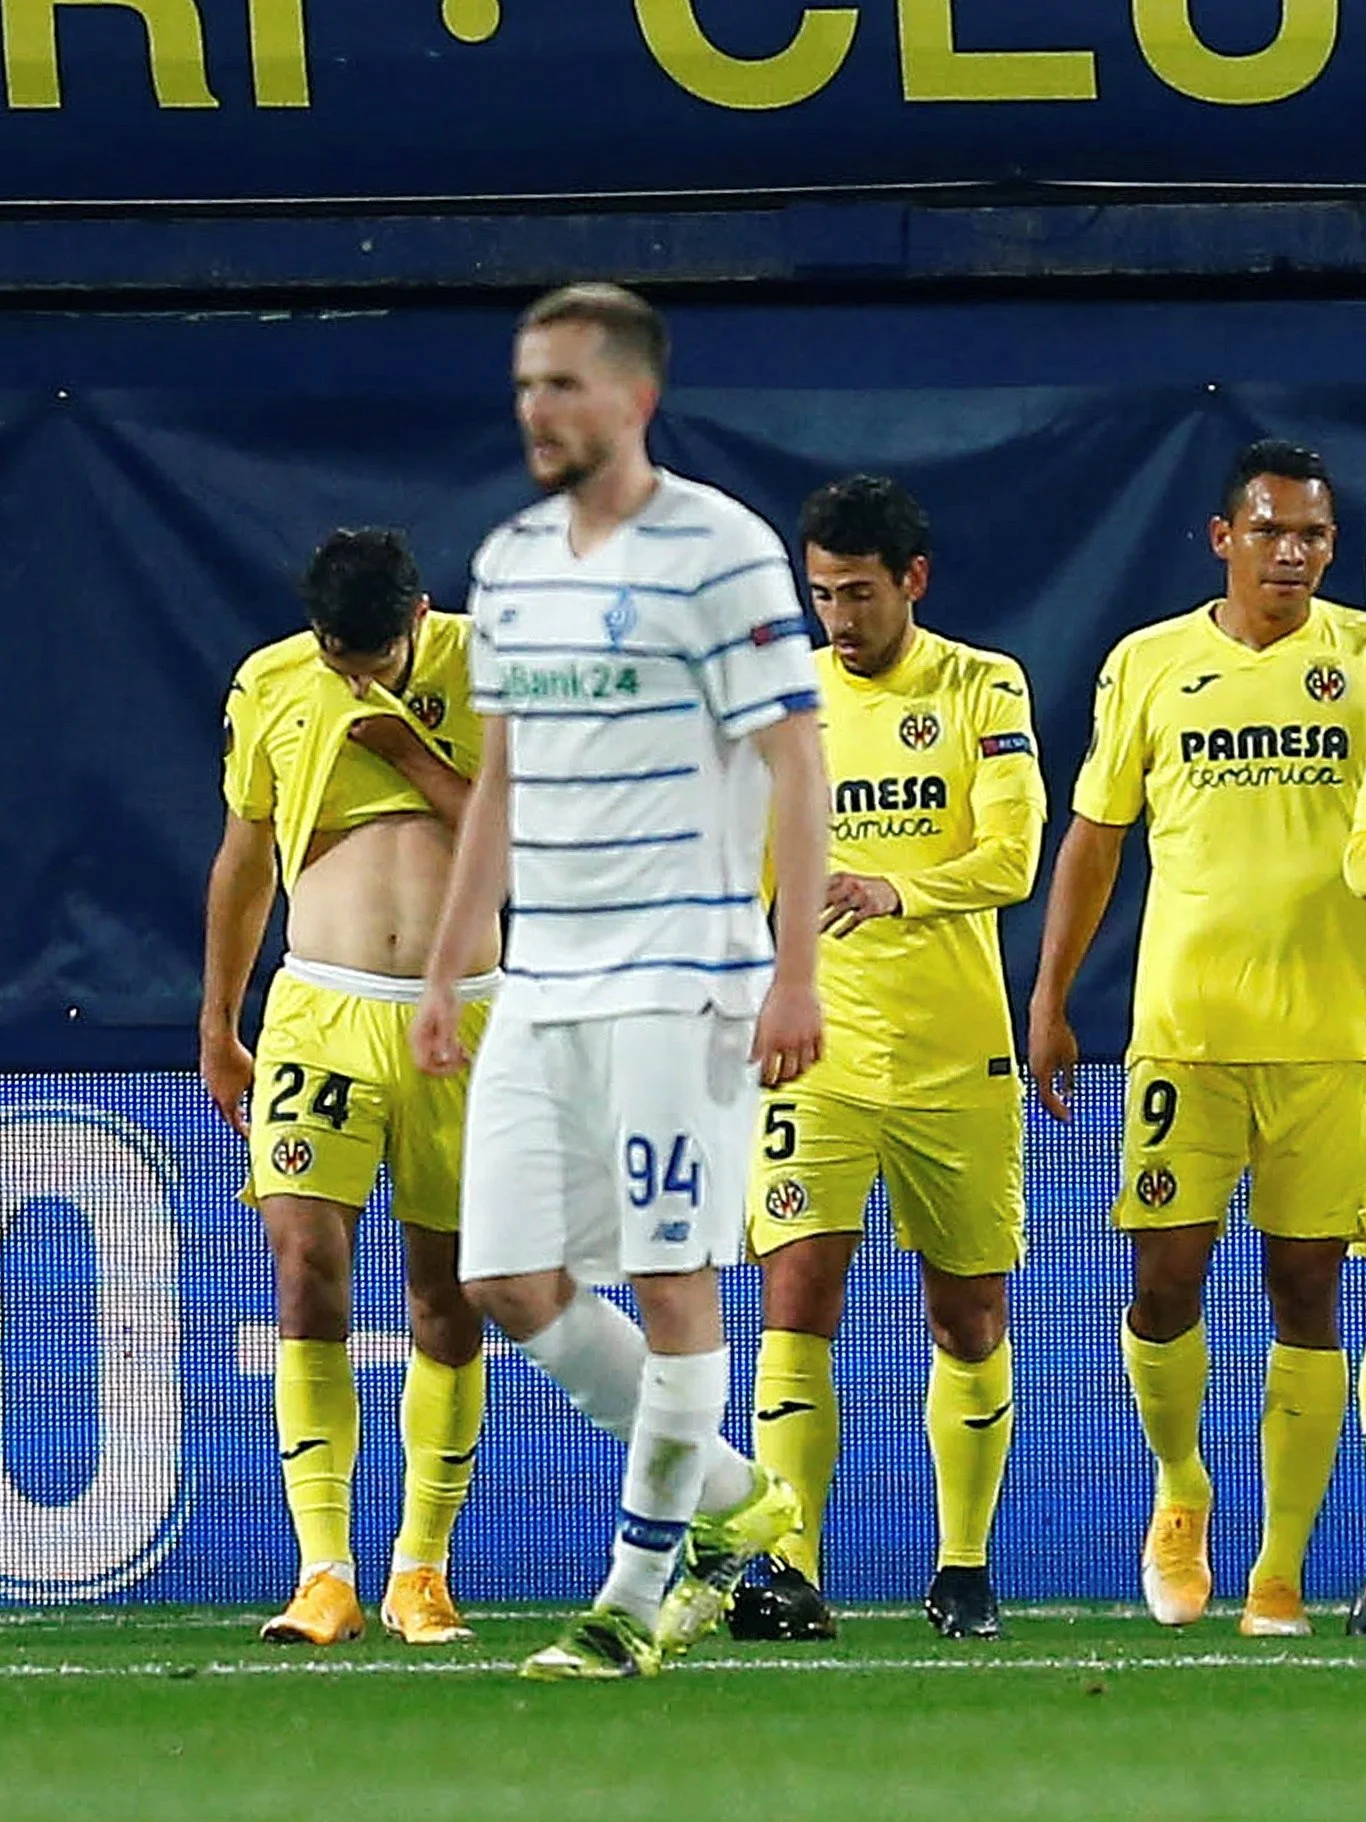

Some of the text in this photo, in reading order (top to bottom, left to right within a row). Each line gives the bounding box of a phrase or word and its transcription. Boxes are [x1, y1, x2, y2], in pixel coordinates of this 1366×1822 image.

[1181, 726, 1349, 764] PAMESA
[835, 776, 948, 814] MESA
[267, 1063, 353, 1130] 24
[1142, 1079, 1178, 1148] 9
[764, 1103, 798, 1160] 5
[625, 1134, 701, 1208] 94
